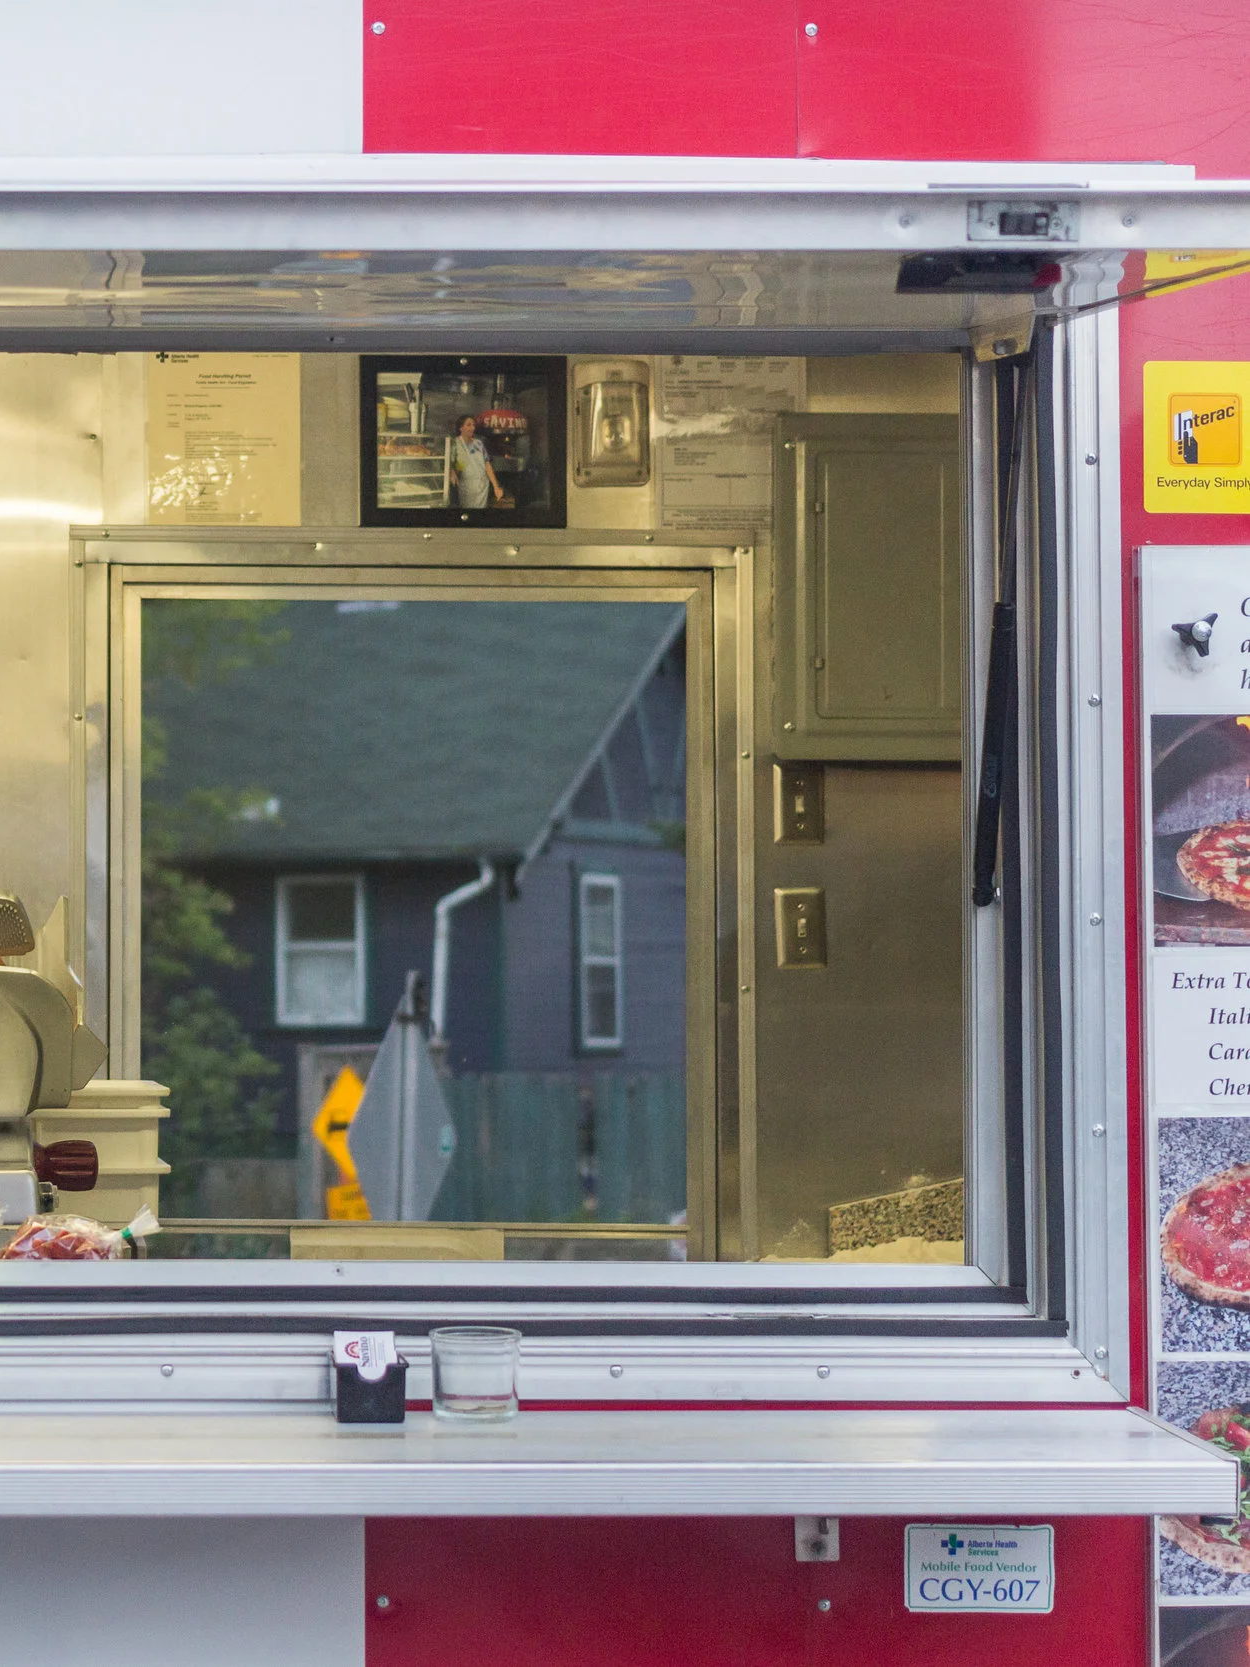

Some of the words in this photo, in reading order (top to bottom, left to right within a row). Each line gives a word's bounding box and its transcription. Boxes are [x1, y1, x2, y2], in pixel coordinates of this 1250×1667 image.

[1178, 405, 1235, 440] Interac
[1157, 476, 1211, 490] Everyday
[1172, 971, 1226, 989] Extra
[968, 1539, 993, 1548] Alberta
[994, 1539, 1018, 1548] Health
[968, 1548, 999, 1556] Services
[921, 1561, 960, 1572] Mobile
[964, 1561, 993, 1572] Food
[996, 1562, 1037, 1573] Vendor
[919, 1577, 1041, 1602] CGY-607
